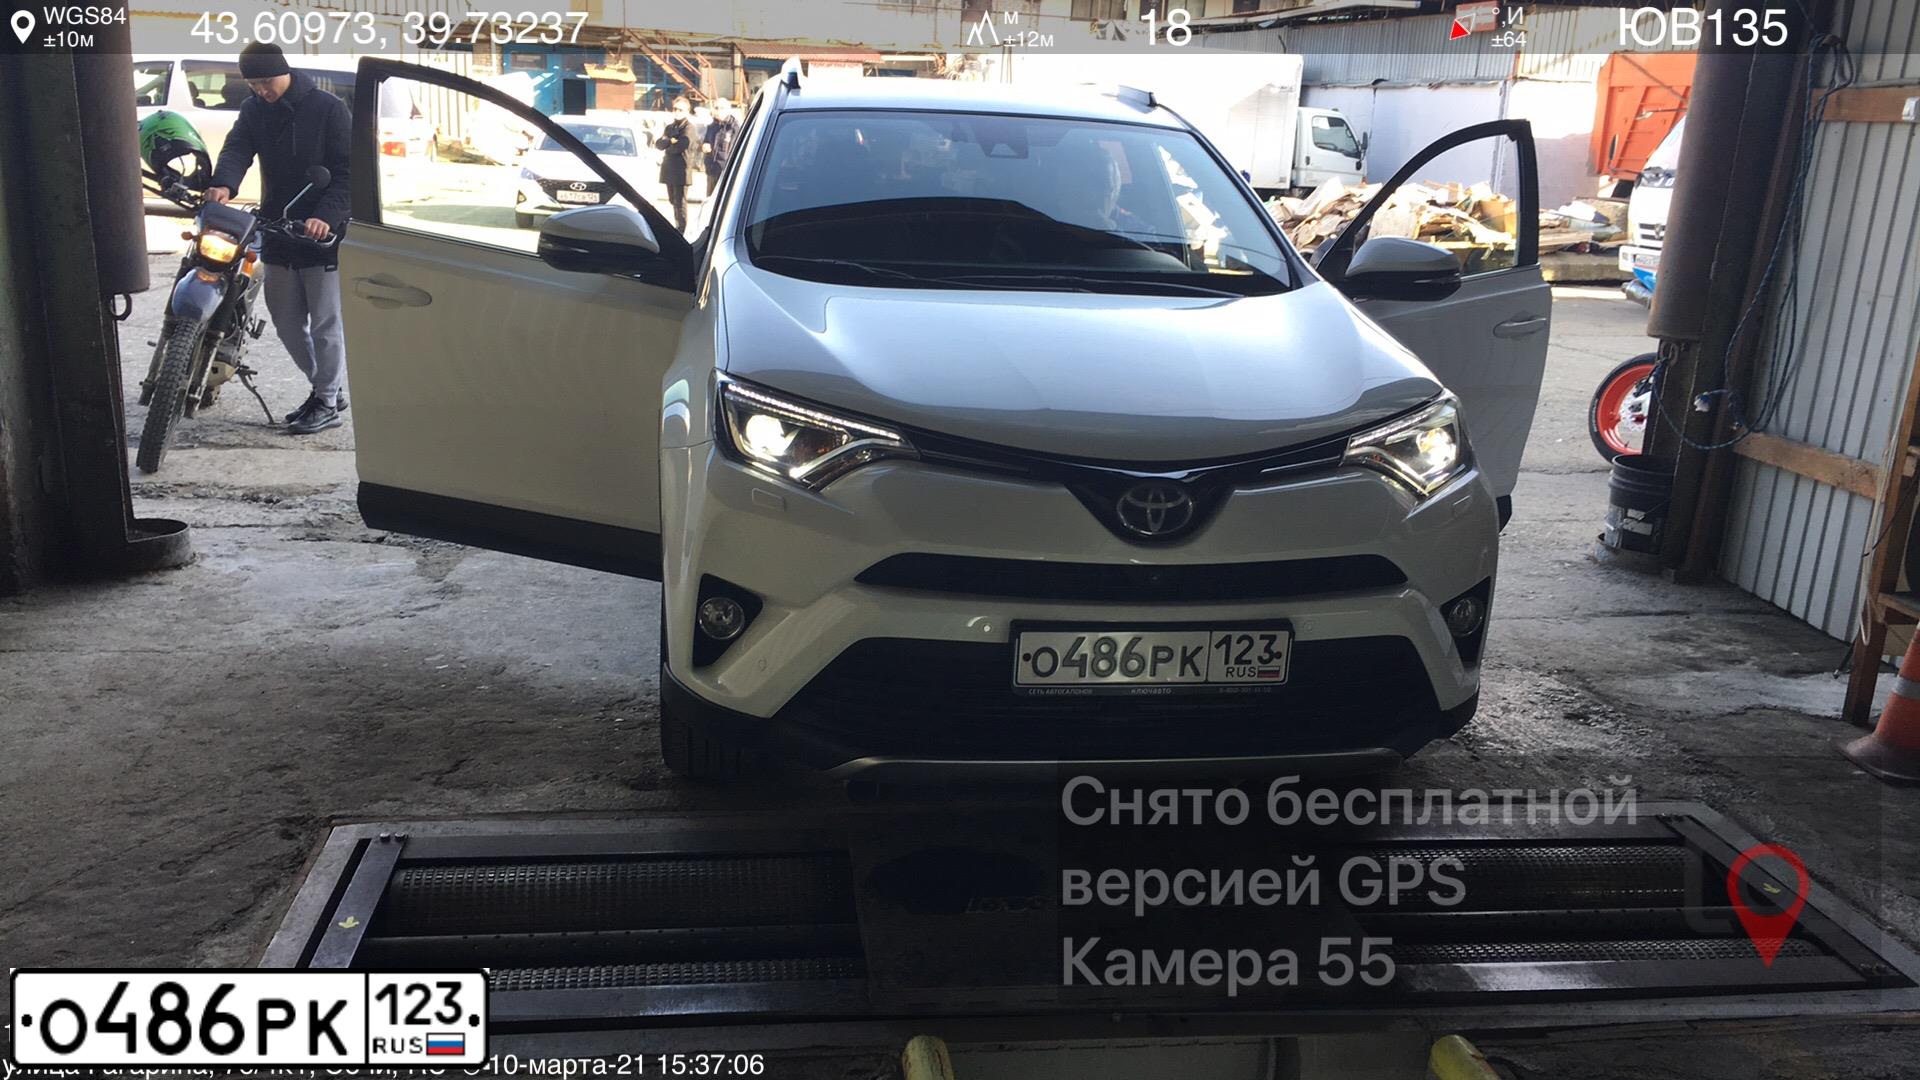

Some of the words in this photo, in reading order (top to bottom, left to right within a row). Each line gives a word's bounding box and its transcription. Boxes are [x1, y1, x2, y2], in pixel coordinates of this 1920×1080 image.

[1031, 636, 1204, 678] О486РК
[1213, 634, 1278, 665] 123
[1225, 666, 1257, 678] RUS
